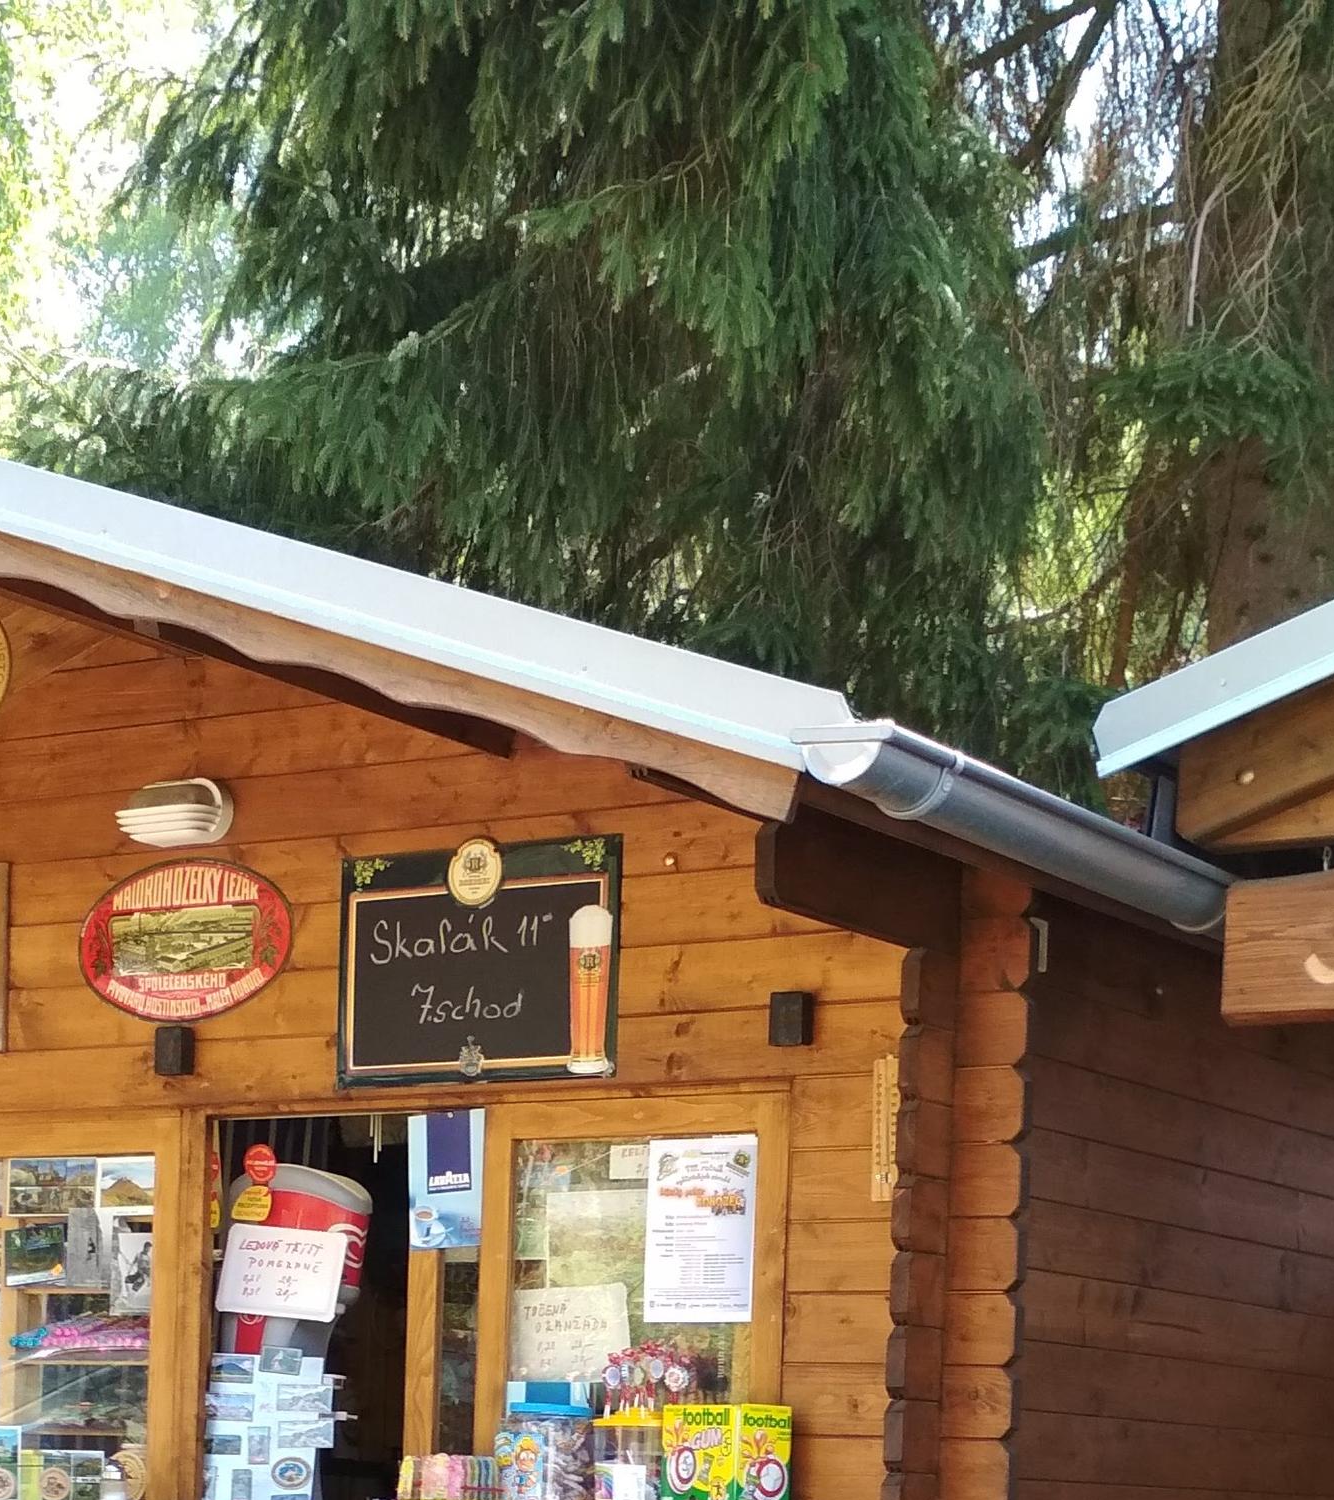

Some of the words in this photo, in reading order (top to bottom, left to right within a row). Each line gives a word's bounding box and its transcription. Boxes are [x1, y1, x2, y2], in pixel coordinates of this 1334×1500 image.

[683, 1408, 730, 1426] football
[743, 1413, 791, 1429] footbal
[691, 1428, 723, 1450] GUM
